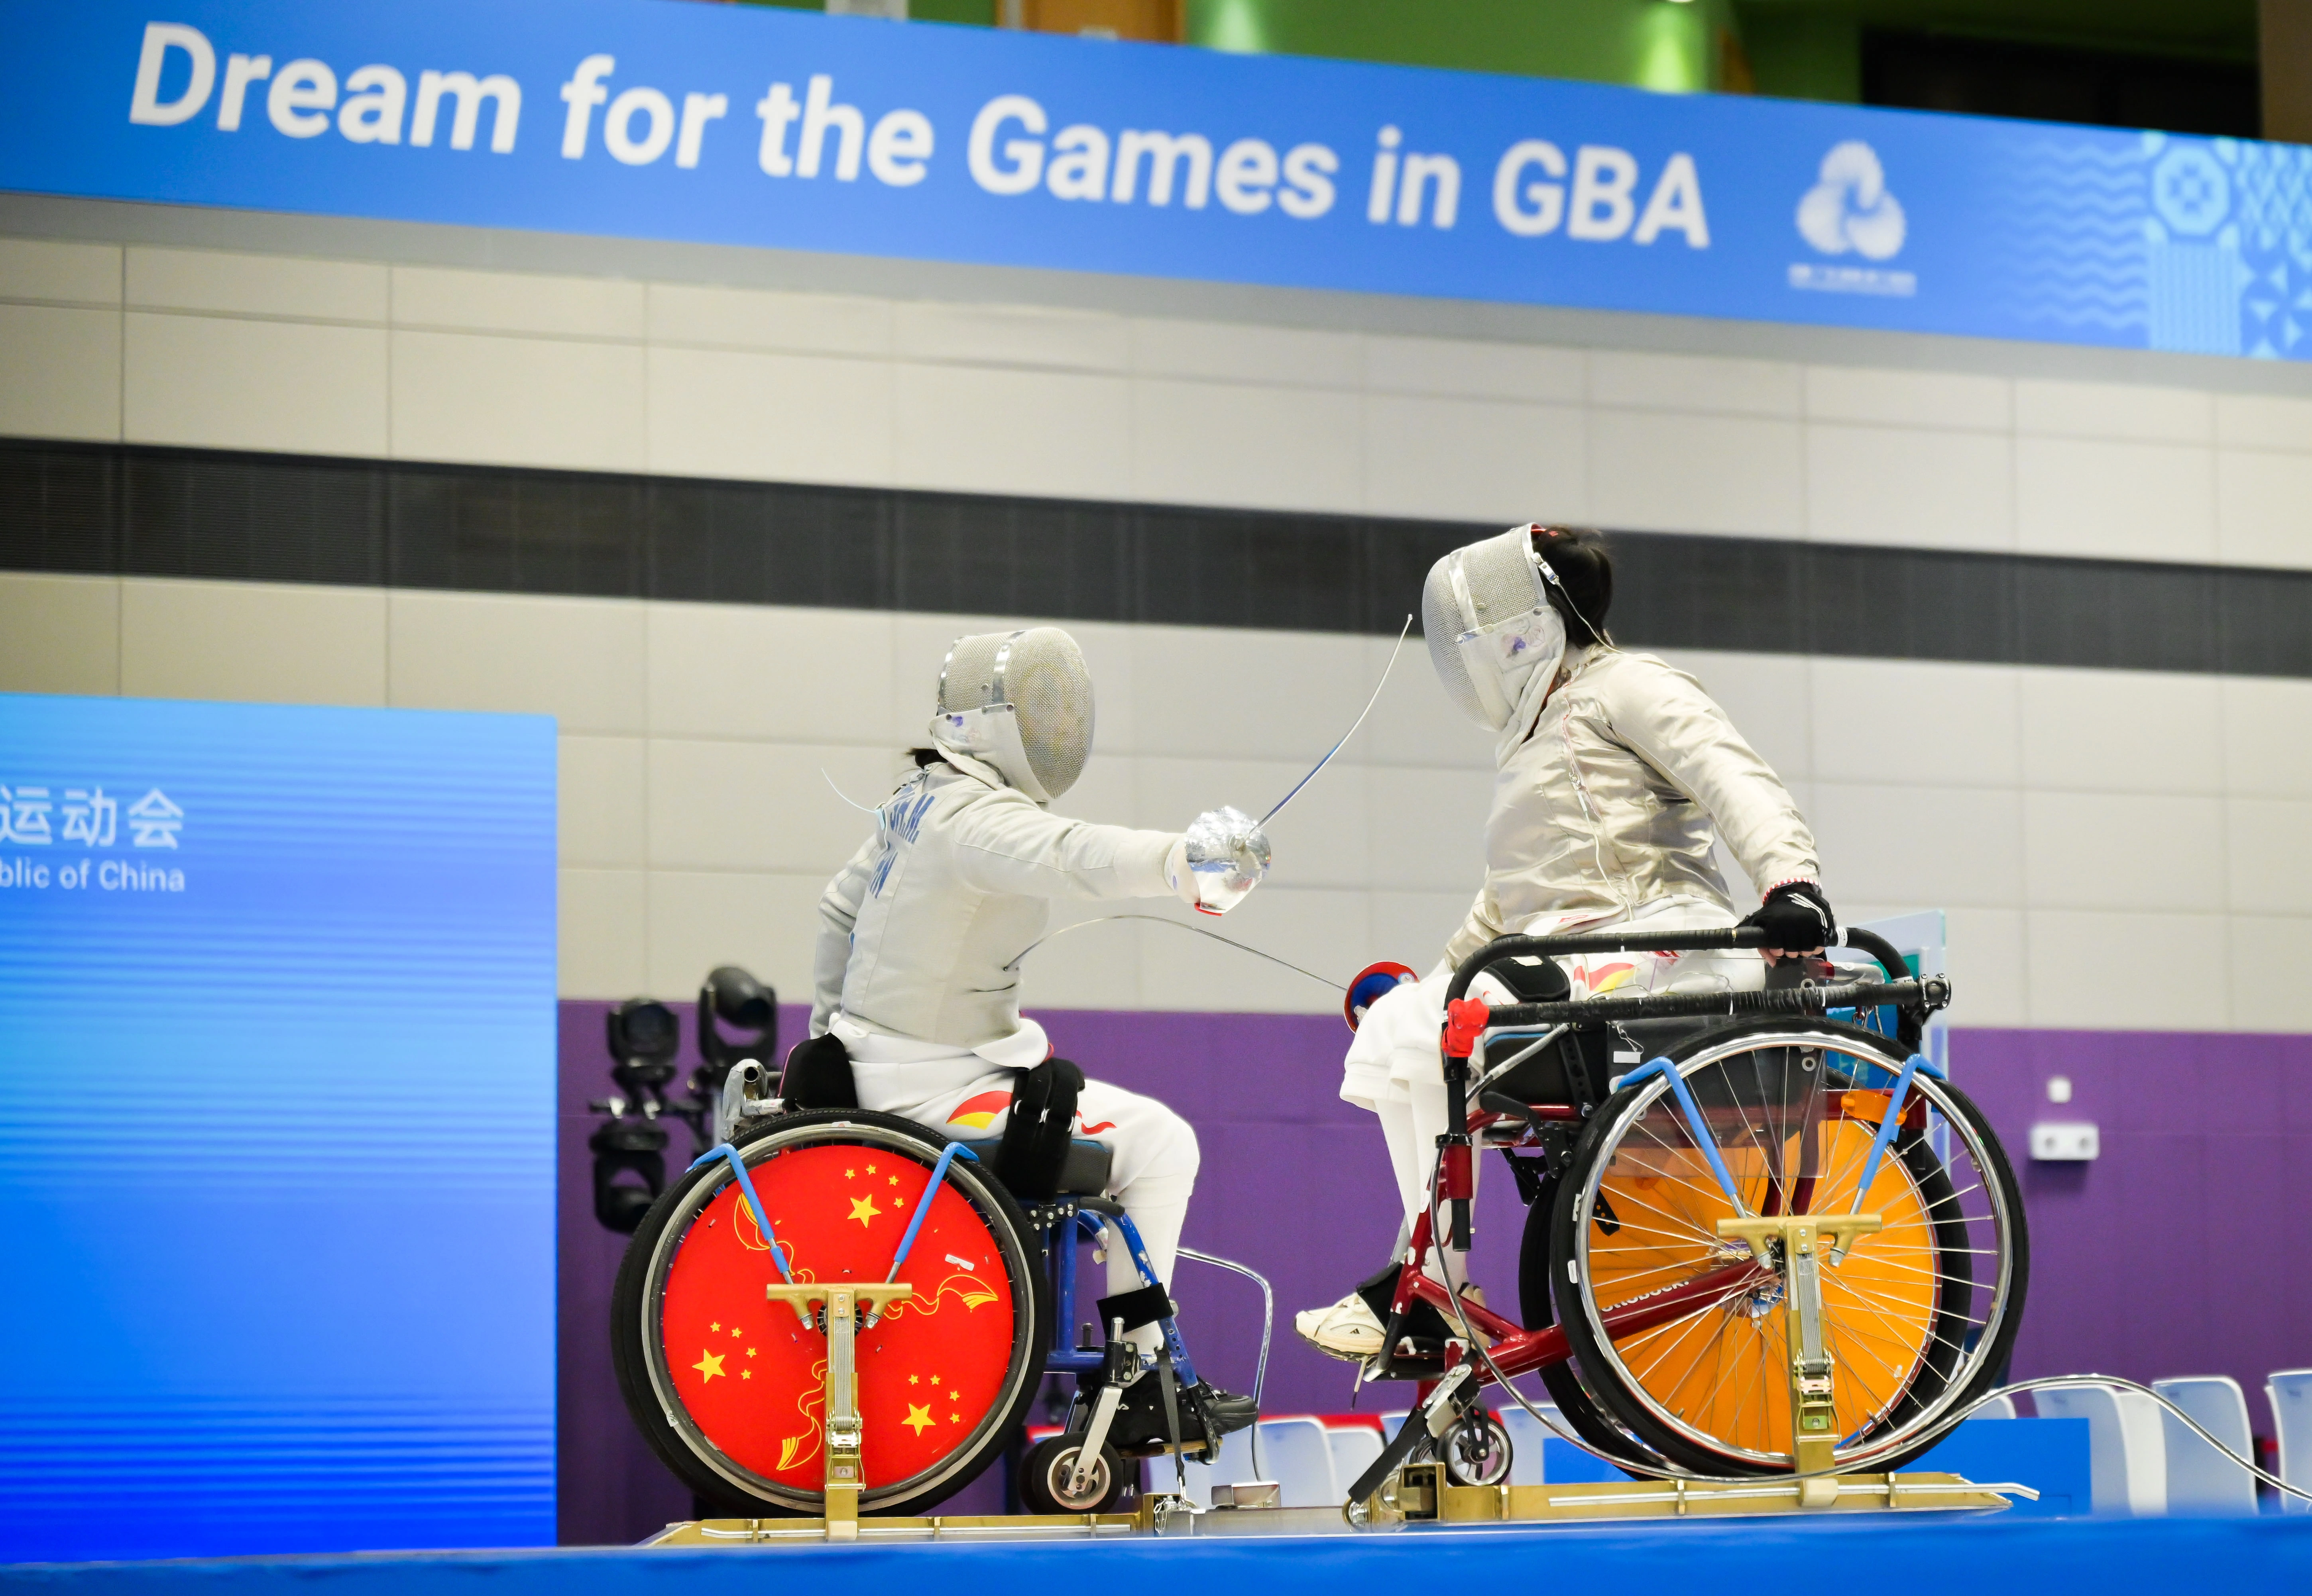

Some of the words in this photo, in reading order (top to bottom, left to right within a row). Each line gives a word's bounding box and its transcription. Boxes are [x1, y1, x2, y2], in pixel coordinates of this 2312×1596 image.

[132, 26, 521, 153] Dream
[561, 55, 727, 168] for
[757, 75, 933, 186] the
[968, 96, 1337, 217] Games
[1370, 128, 1459, 227] in
[1495, 143, 1708, 247] GBA
[0, 785, 185, 850] 运动会
[59, 858, 91, 889] of
[99, 860, 185, 892] China
